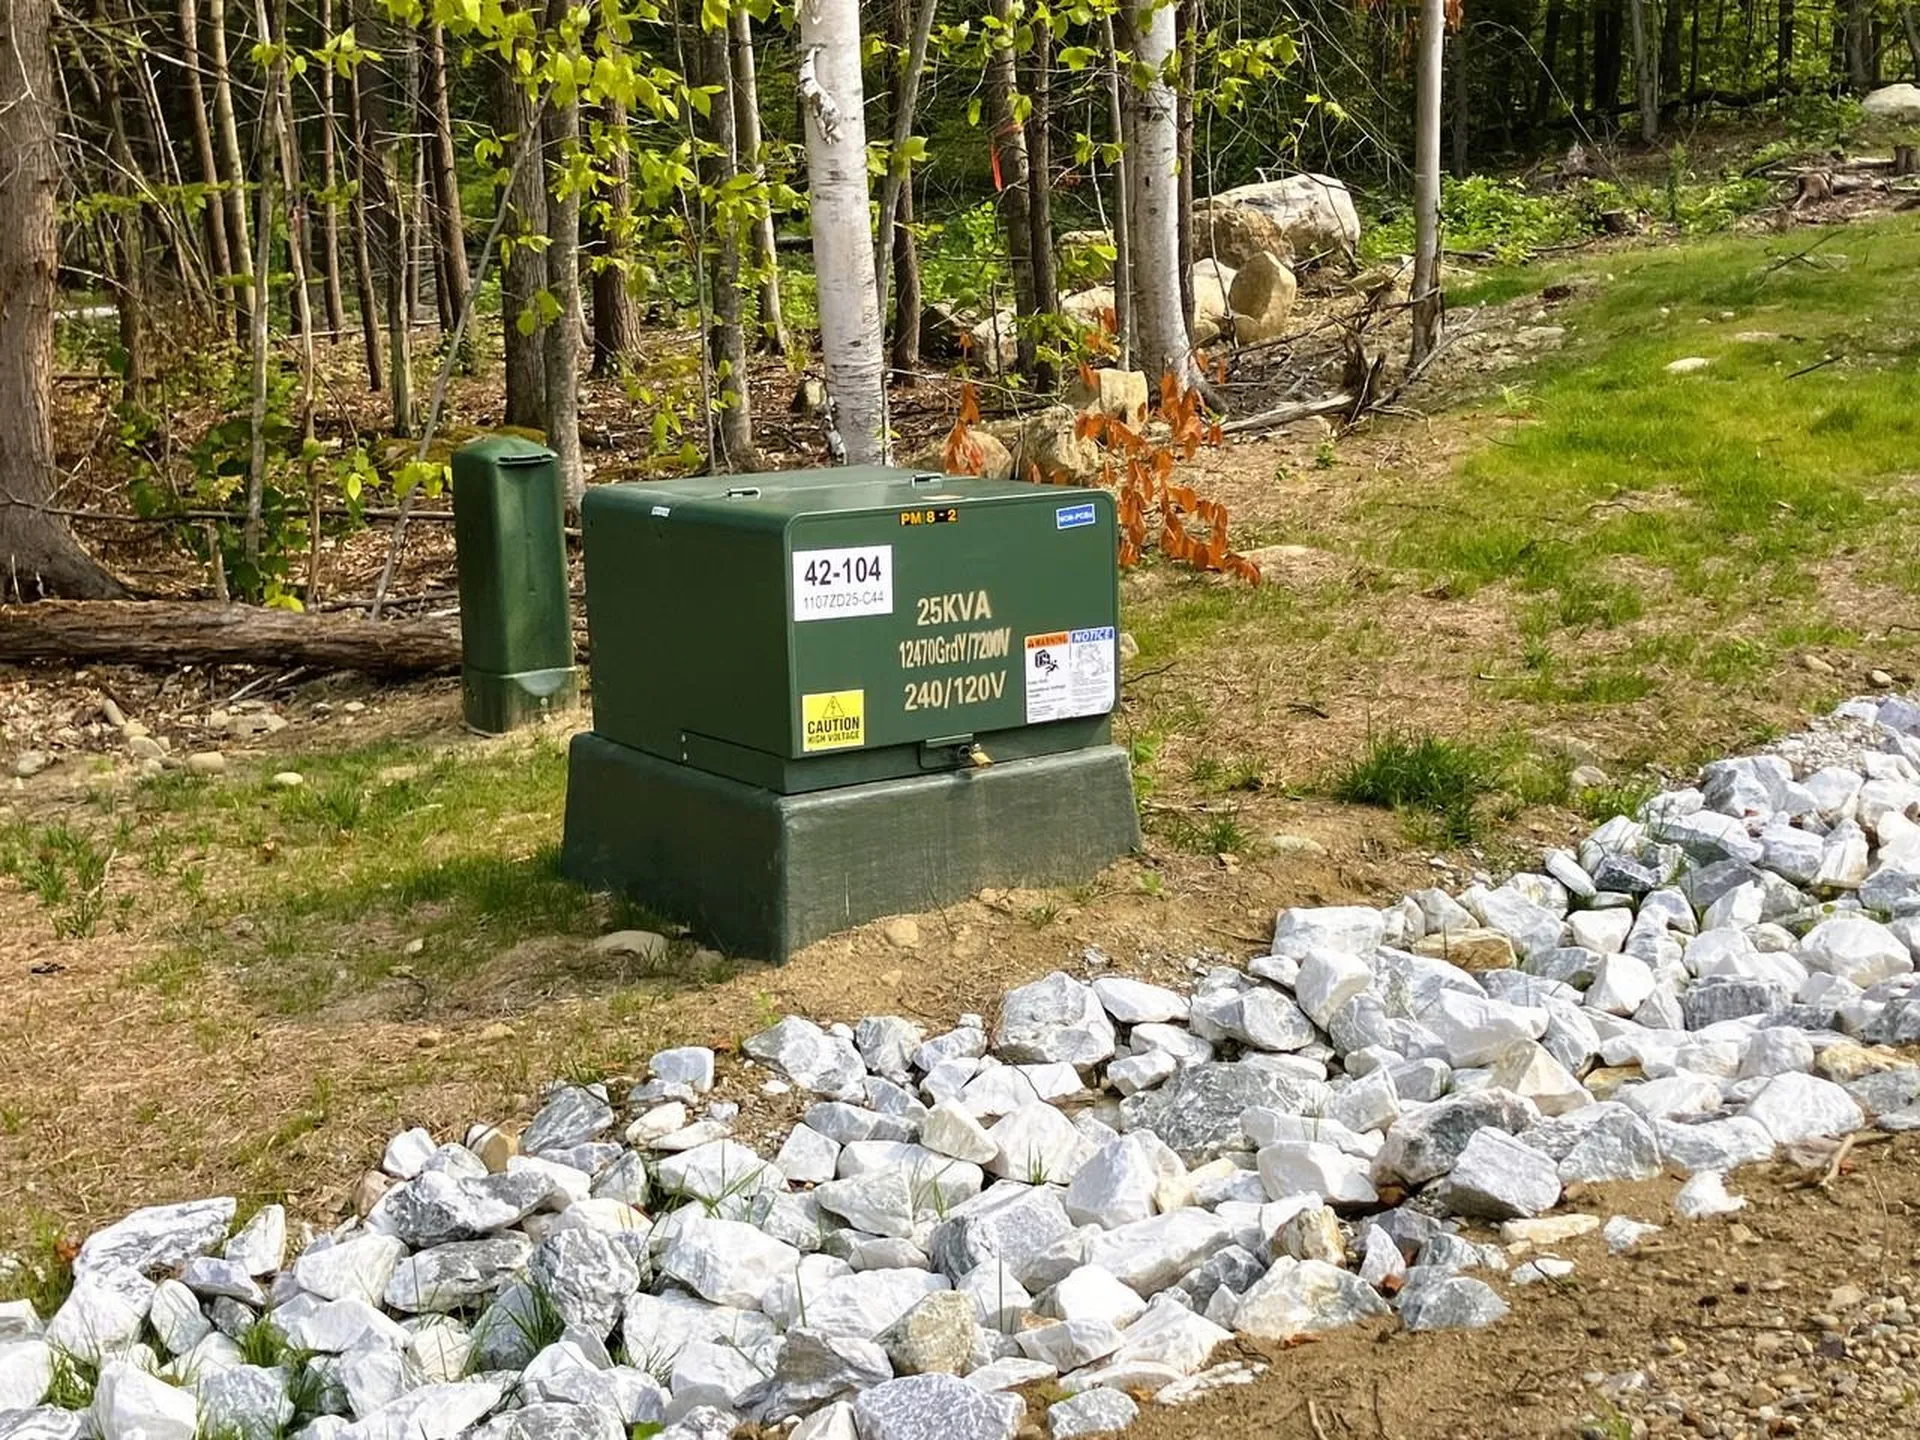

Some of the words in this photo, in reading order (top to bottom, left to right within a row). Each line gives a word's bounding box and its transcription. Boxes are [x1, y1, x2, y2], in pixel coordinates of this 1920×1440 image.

[901, 511, 921, 525] PM
[804, 556, 881, 586] 42-104
[917, 590, 992, 625] 25KVA
[1074, 629, 1111, 642] NOTICE
[899, 627, 1011, 669] 12470GrdY/7200V
[904, 670, 1006, 710] 240/120V
[807, 717, 859, 735] CAUTION
[808, 734, 826, 744] HIGH
[828, 731, 859, 742] VOLTAGE
